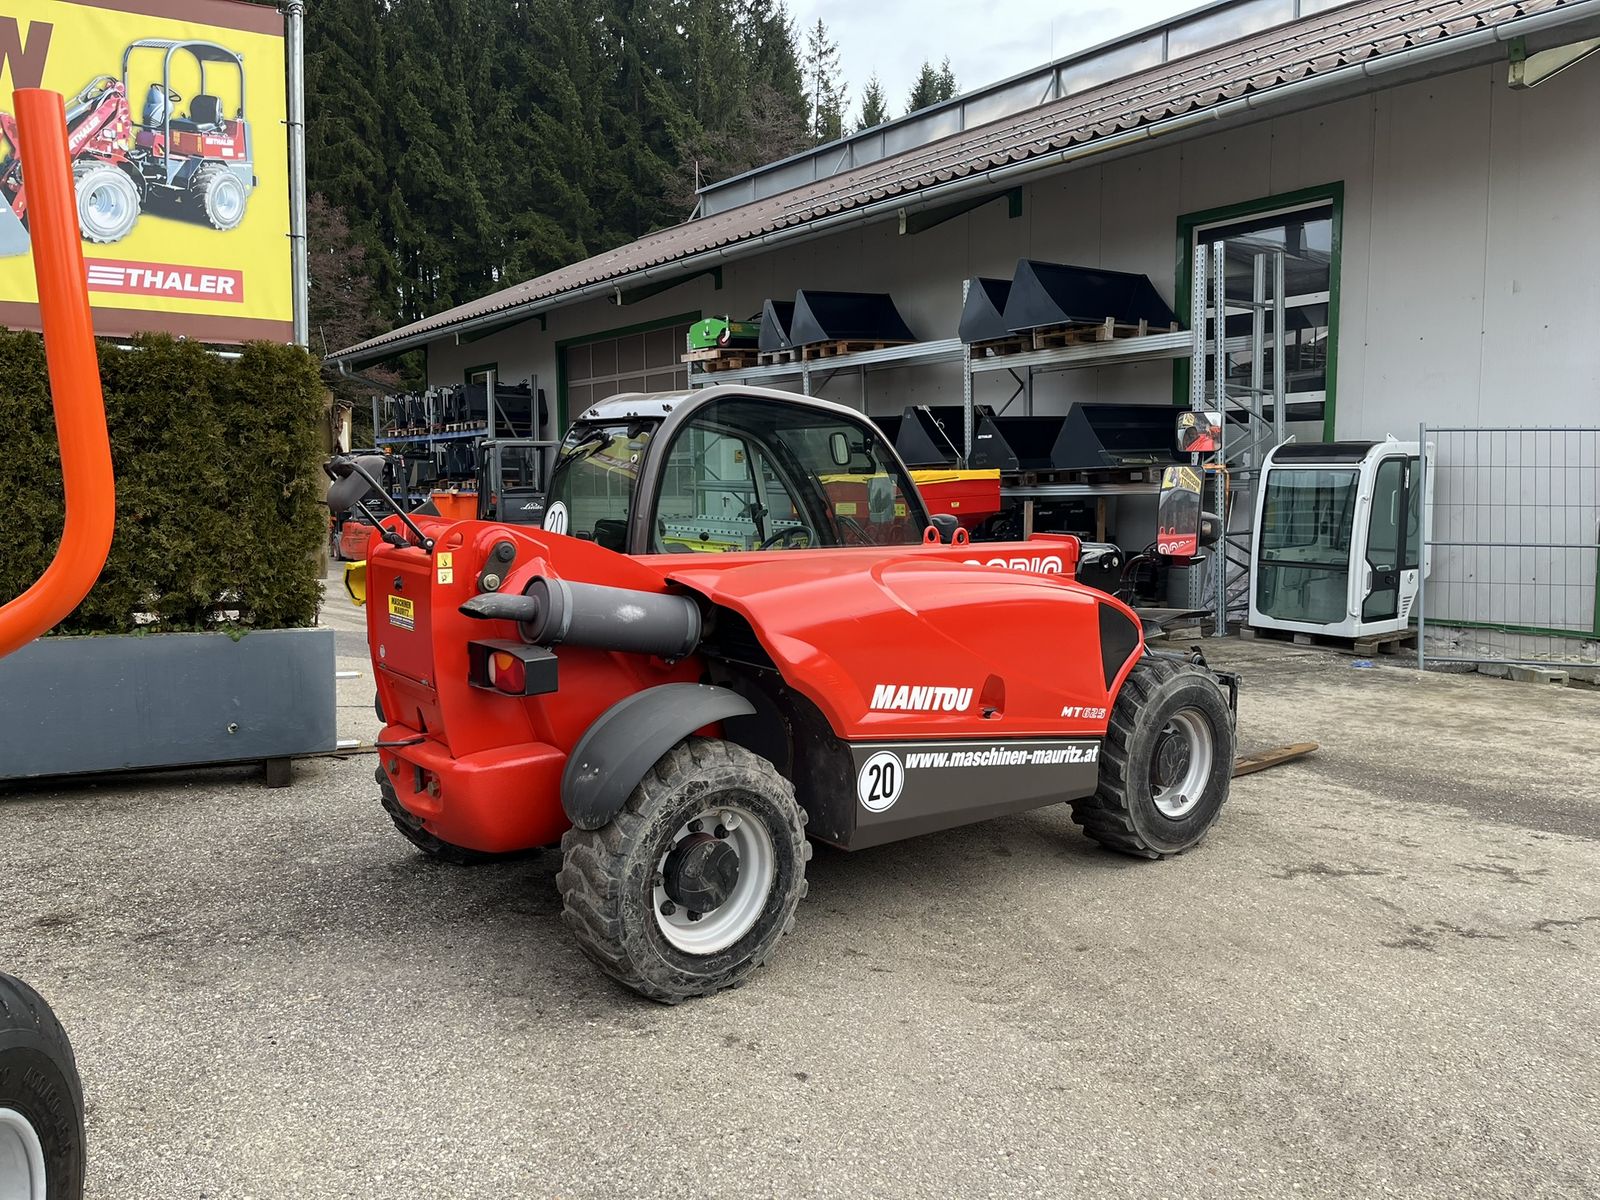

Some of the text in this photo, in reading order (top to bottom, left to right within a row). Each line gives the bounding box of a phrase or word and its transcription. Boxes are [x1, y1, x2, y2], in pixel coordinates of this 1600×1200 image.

[125, 268, 235, 295] THALER
[549, 510, 564, 535] 20
[870, 684, 973, 712] MANITOU
[905, 745, 1098, 769] www.maschinen-mauritz.at
[868, 762, 894, 801] 20
